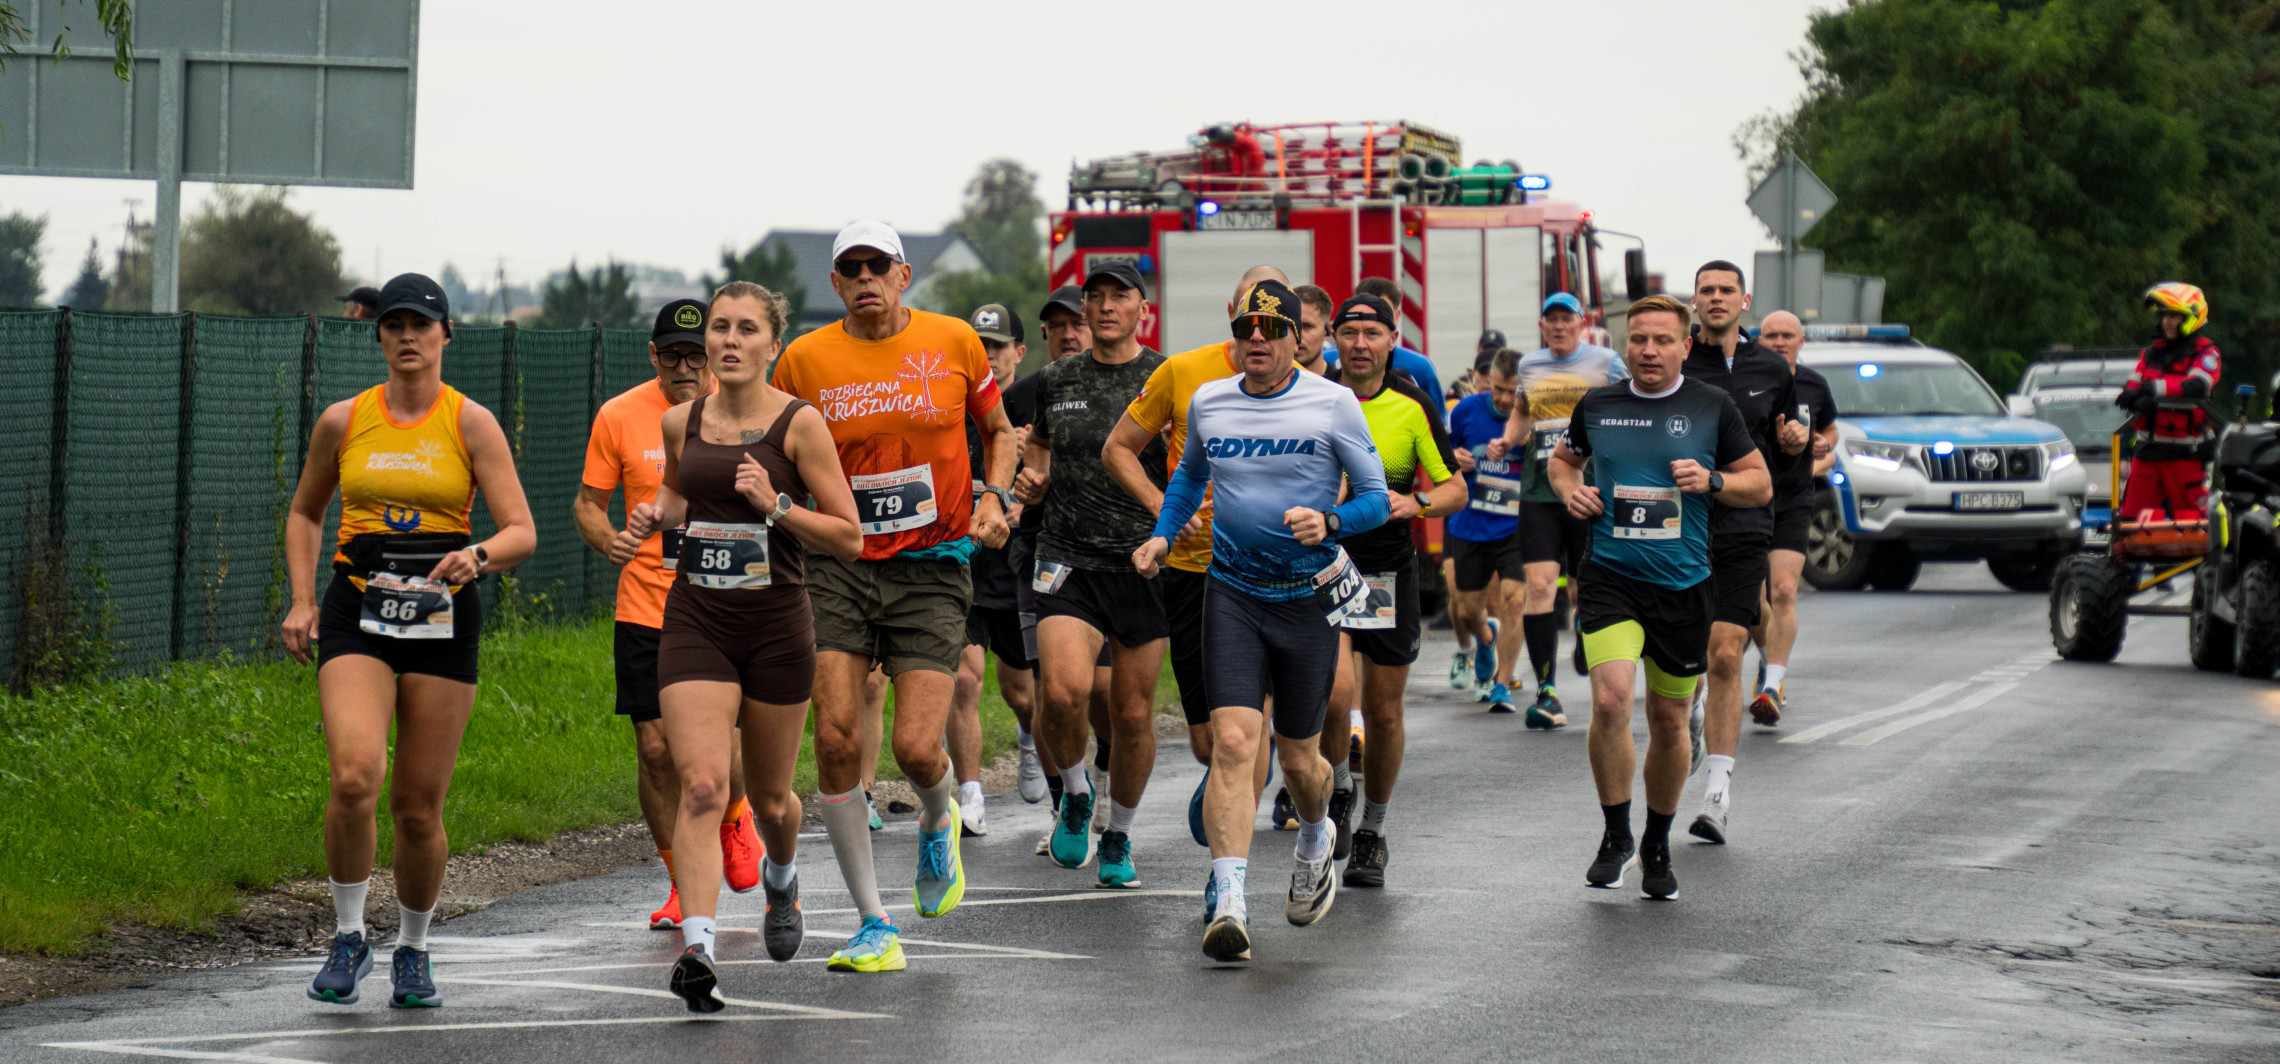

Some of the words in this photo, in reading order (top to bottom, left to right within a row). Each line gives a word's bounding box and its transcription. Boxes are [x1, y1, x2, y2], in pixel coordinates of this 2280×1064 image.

[820, 380, 901, 402] ROZBIEGANA
[823, 393, 925, 422] KRUSZWICA
[1052, 401, 1088, 411] GLIWEK
[1600, 418, 1653, 427] SEBASTIAN
[1207, 437, 1316, 459] GDYNIA
[1479, 460, 1510, 474] WORLD
[872, 495, 903, 517] 79
[1962, 494, 1988, 508] HPC
[1991, 494, 2021, 508] B375
[1632, 507, 1647, 524] 8
[701, 548, 732, 570] 58
[1329, 567, 1360, 605] 104
[380, 599, 418, 621] 86
